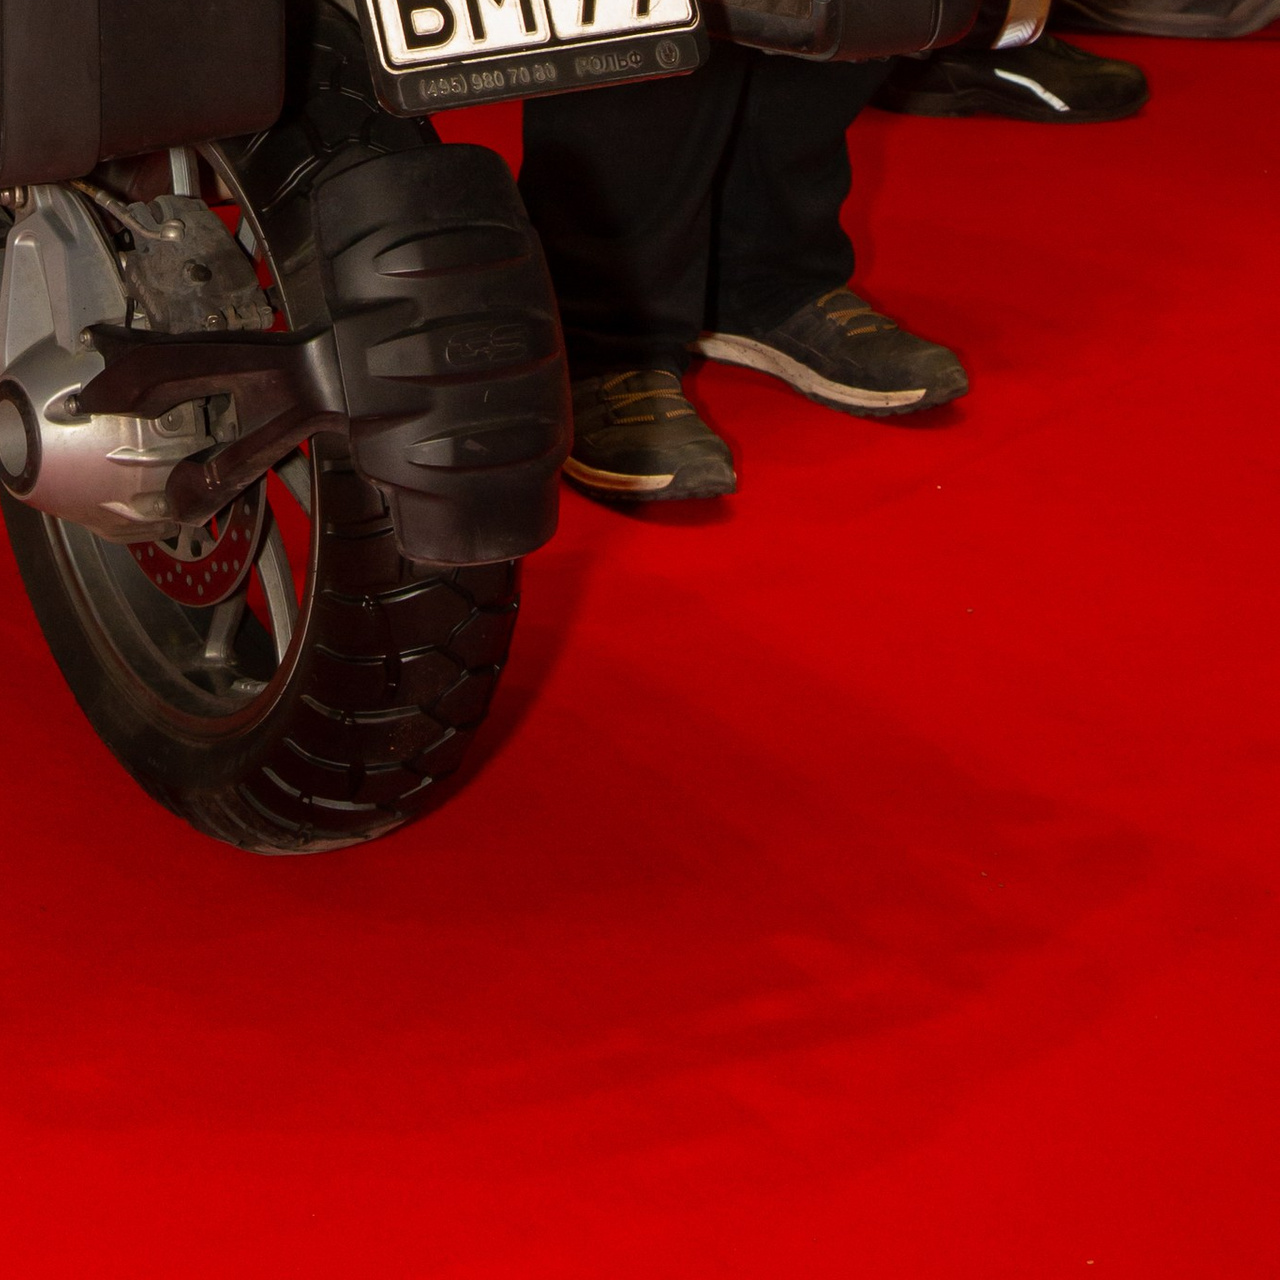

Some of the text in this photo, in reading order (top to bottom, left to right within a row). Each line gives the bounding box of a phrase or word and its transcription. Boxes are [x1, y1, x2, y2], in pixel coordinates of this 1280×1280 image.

[420, 74, 468, 101] (495)
[472, 69, 505, 91] 980
[508, 65, 531, 85] 70
[575, 50, 644, 78] РОЛЬФ
